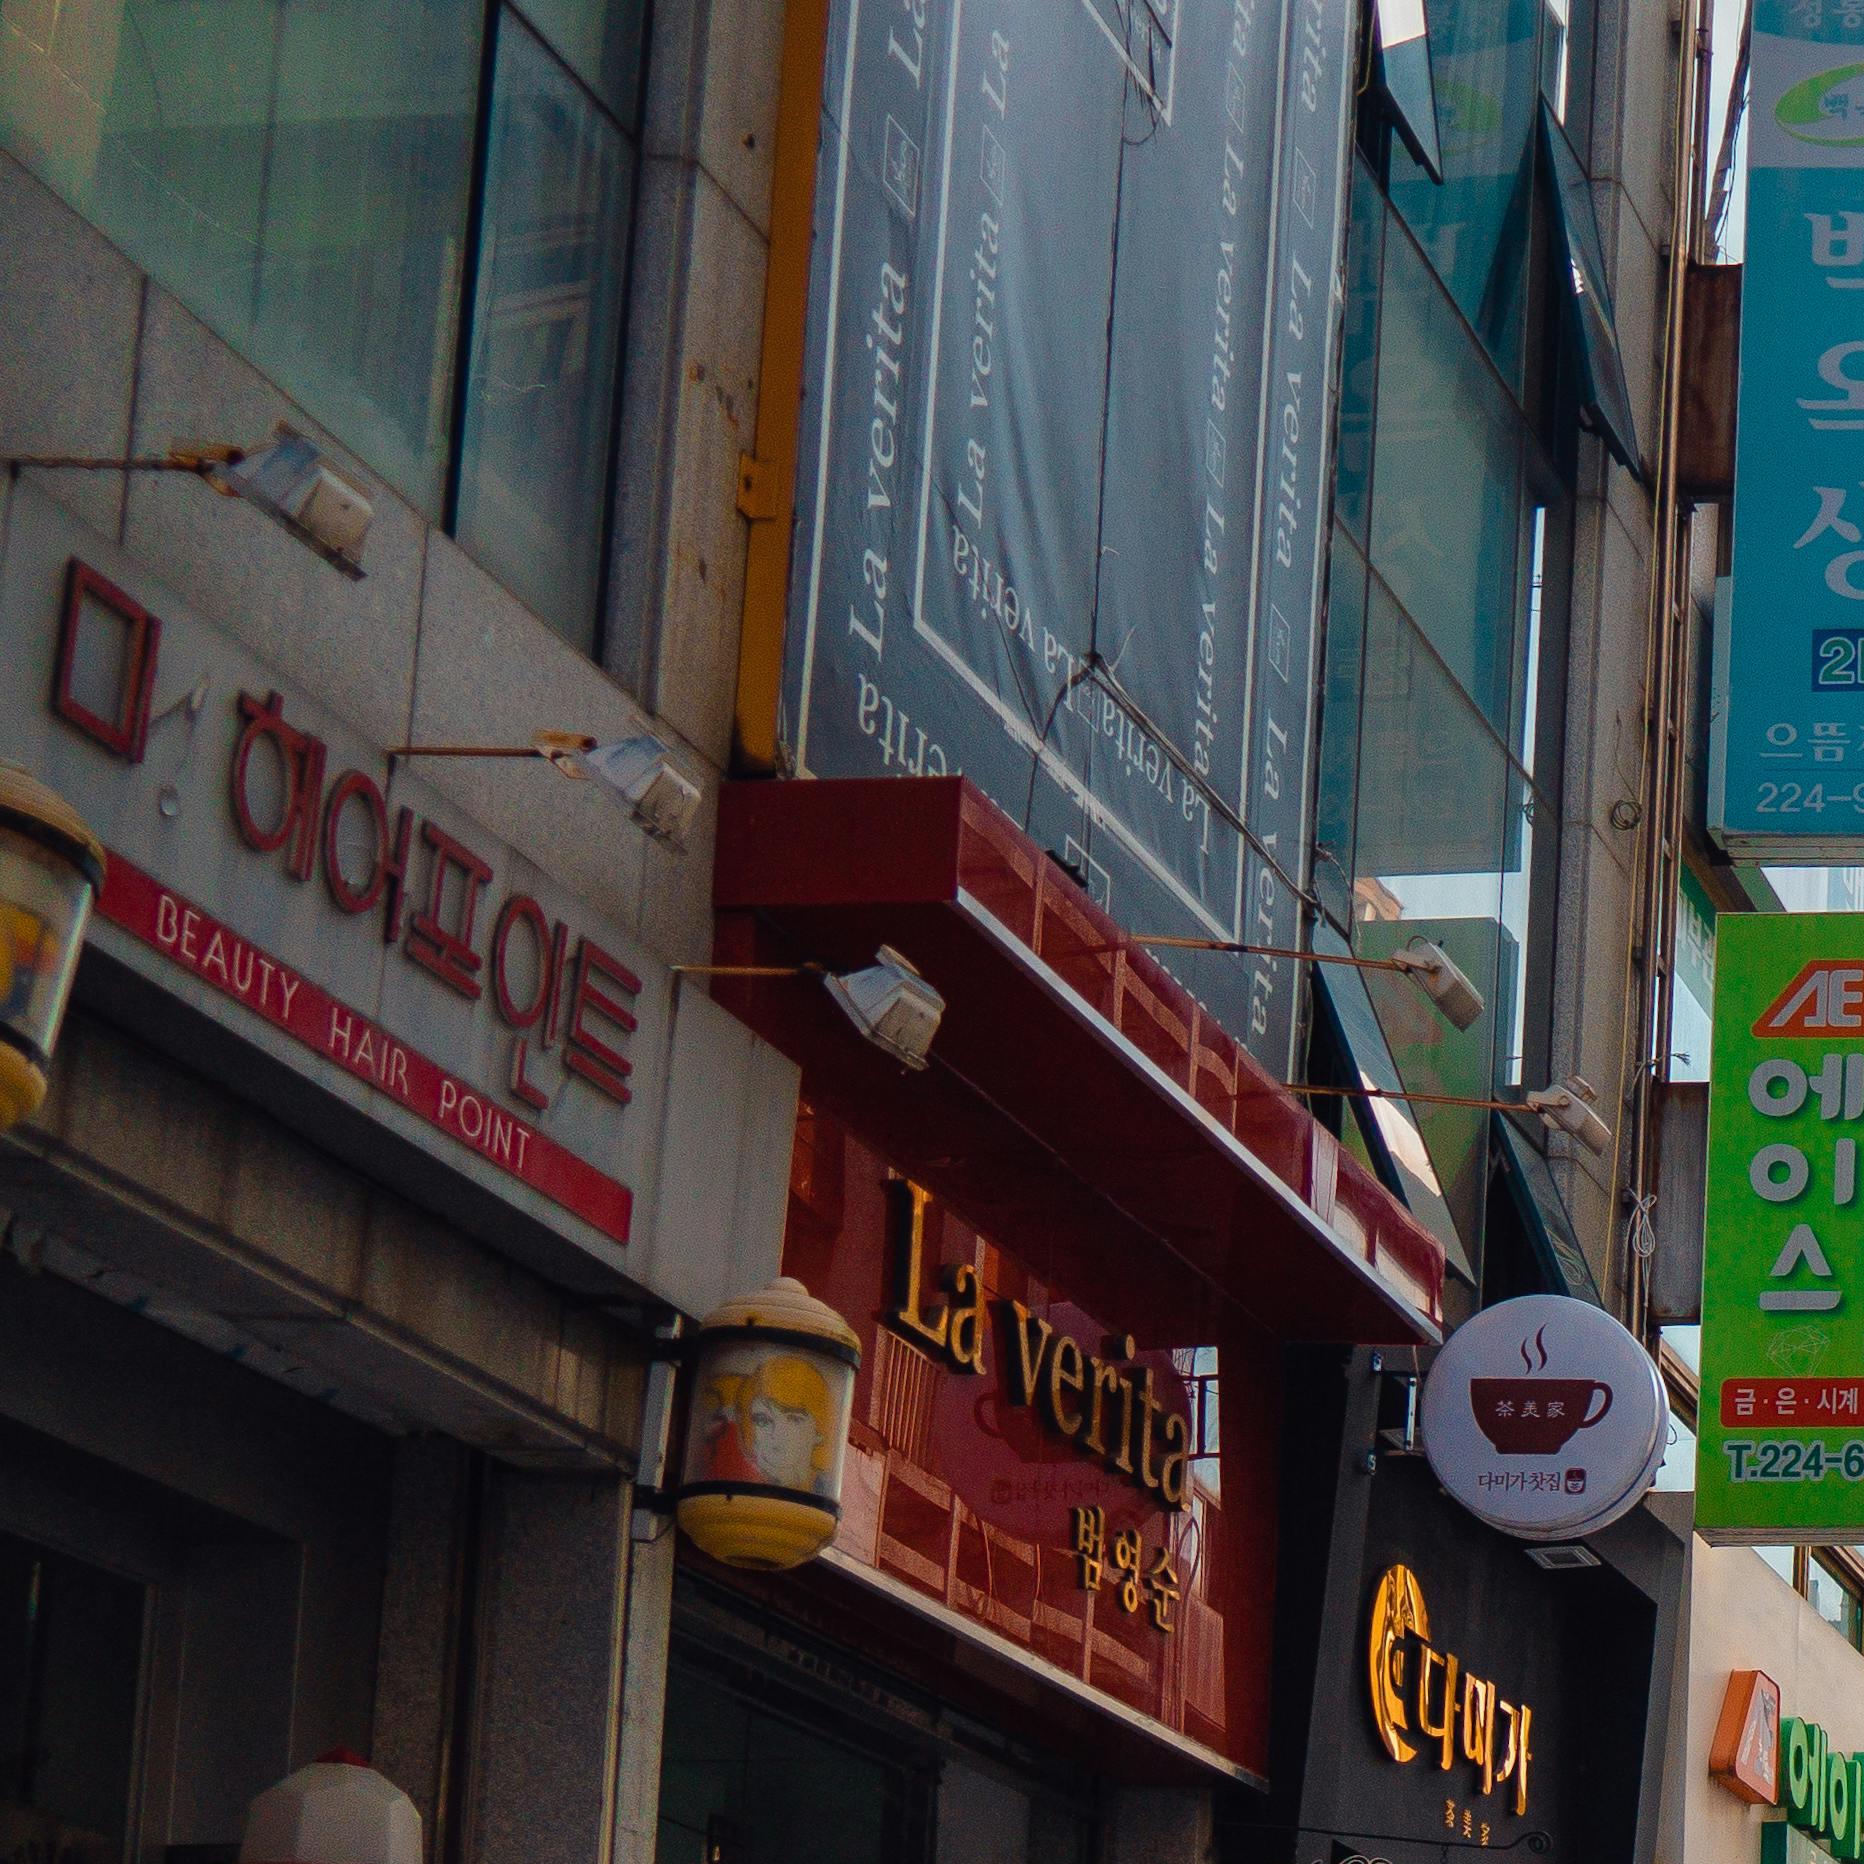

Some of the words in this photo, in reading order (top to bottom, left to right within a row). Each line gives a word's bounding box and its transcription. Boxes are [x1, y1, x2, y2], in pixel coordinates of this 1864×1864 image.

[867, 262, 907, 511] verita
[1289, 252, 1312, 341] La
[1276, 370, 1302, 569] verita
[848, 547, 888, 663] La
[155, 895, 302, 1021] BEAUTY
[328, 1006, 410, 1095] HAIR
[441, 1081, 531, 1171] POINT
[891, 1176, 988, 1377] La
[1010, 1299, 1191, 1512] verita
